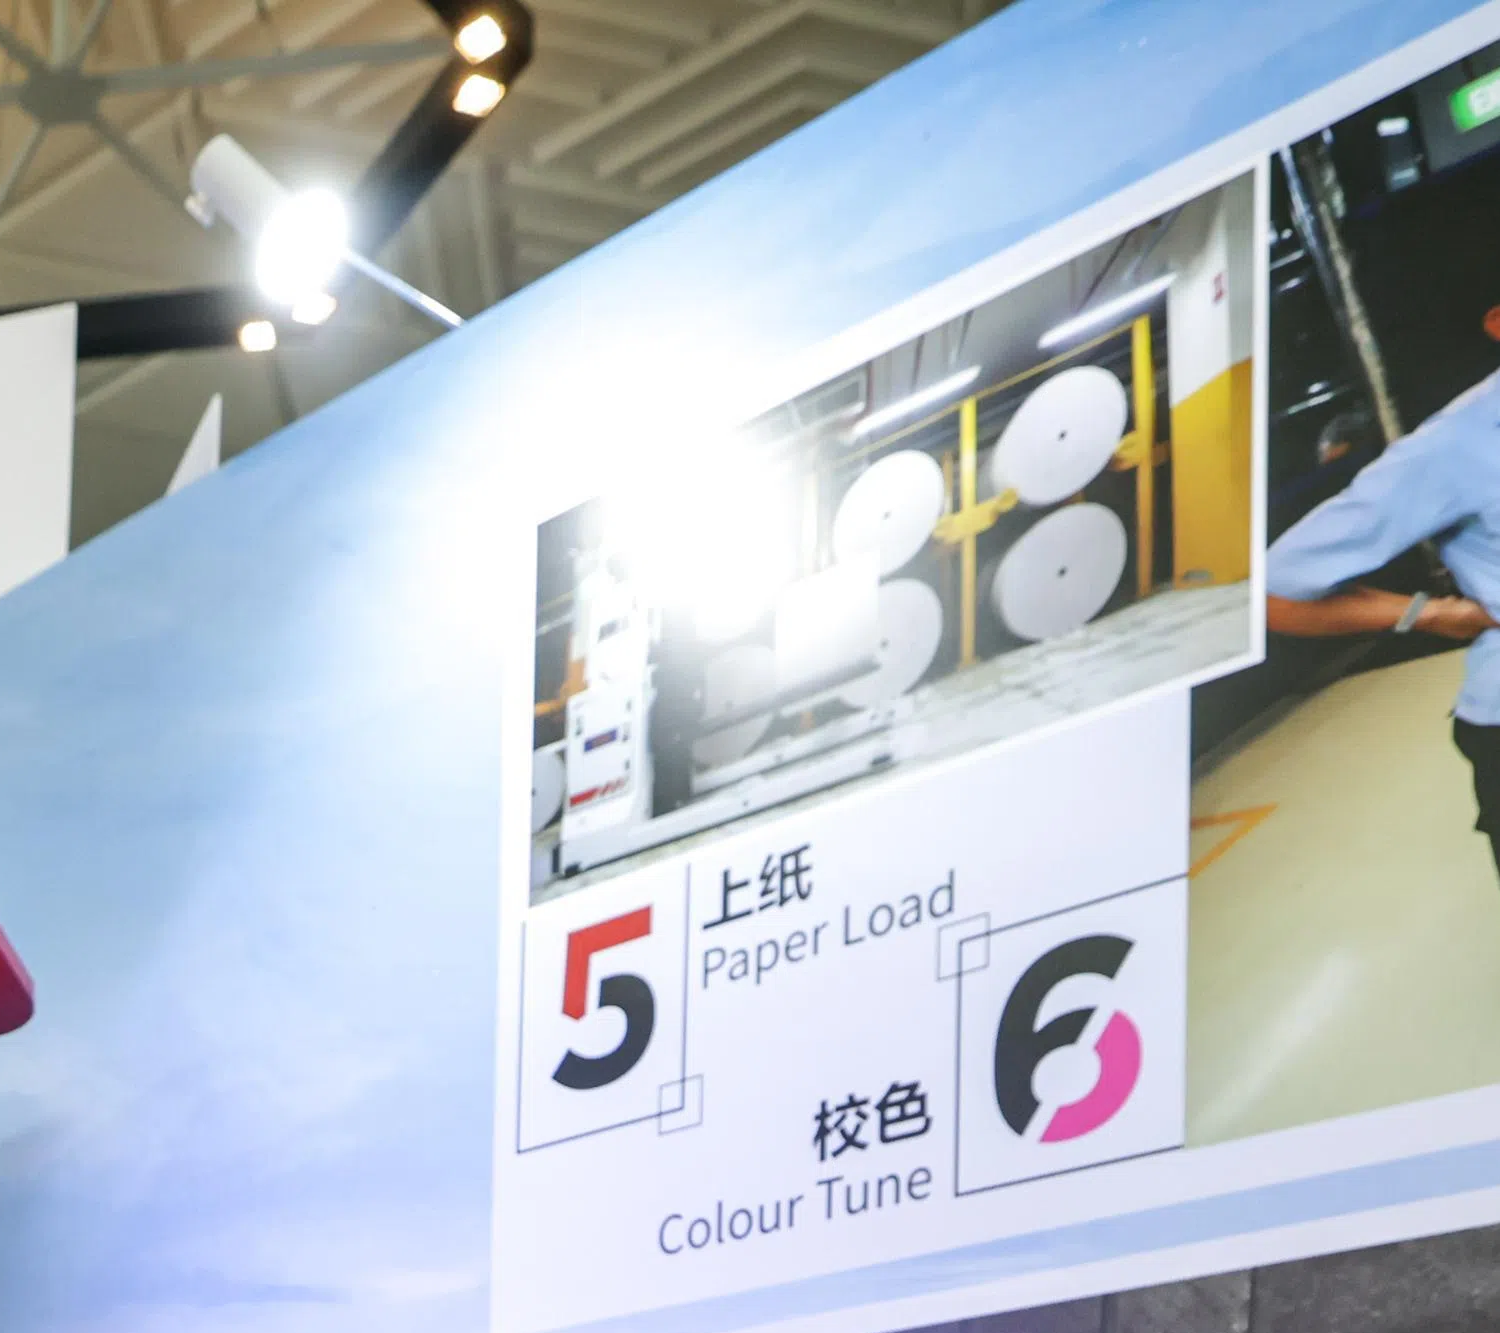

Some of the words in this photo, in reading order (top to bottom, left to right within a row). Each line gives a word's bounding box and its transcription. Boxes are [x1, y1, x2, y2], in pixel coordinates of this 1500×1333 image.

[702, 843, 814, 931] 上纸
[702, 916, 830, 990] Paper
[843, 870, 957, 947] Load
[552, 903, 655, 1091] 5
[994, 933, 1143, 1143] 6
[813, 1081, 934, 1163] 校色
[657, 1194, 804, 1257] Colour
[815, 1165, 934, 1223] Tune
